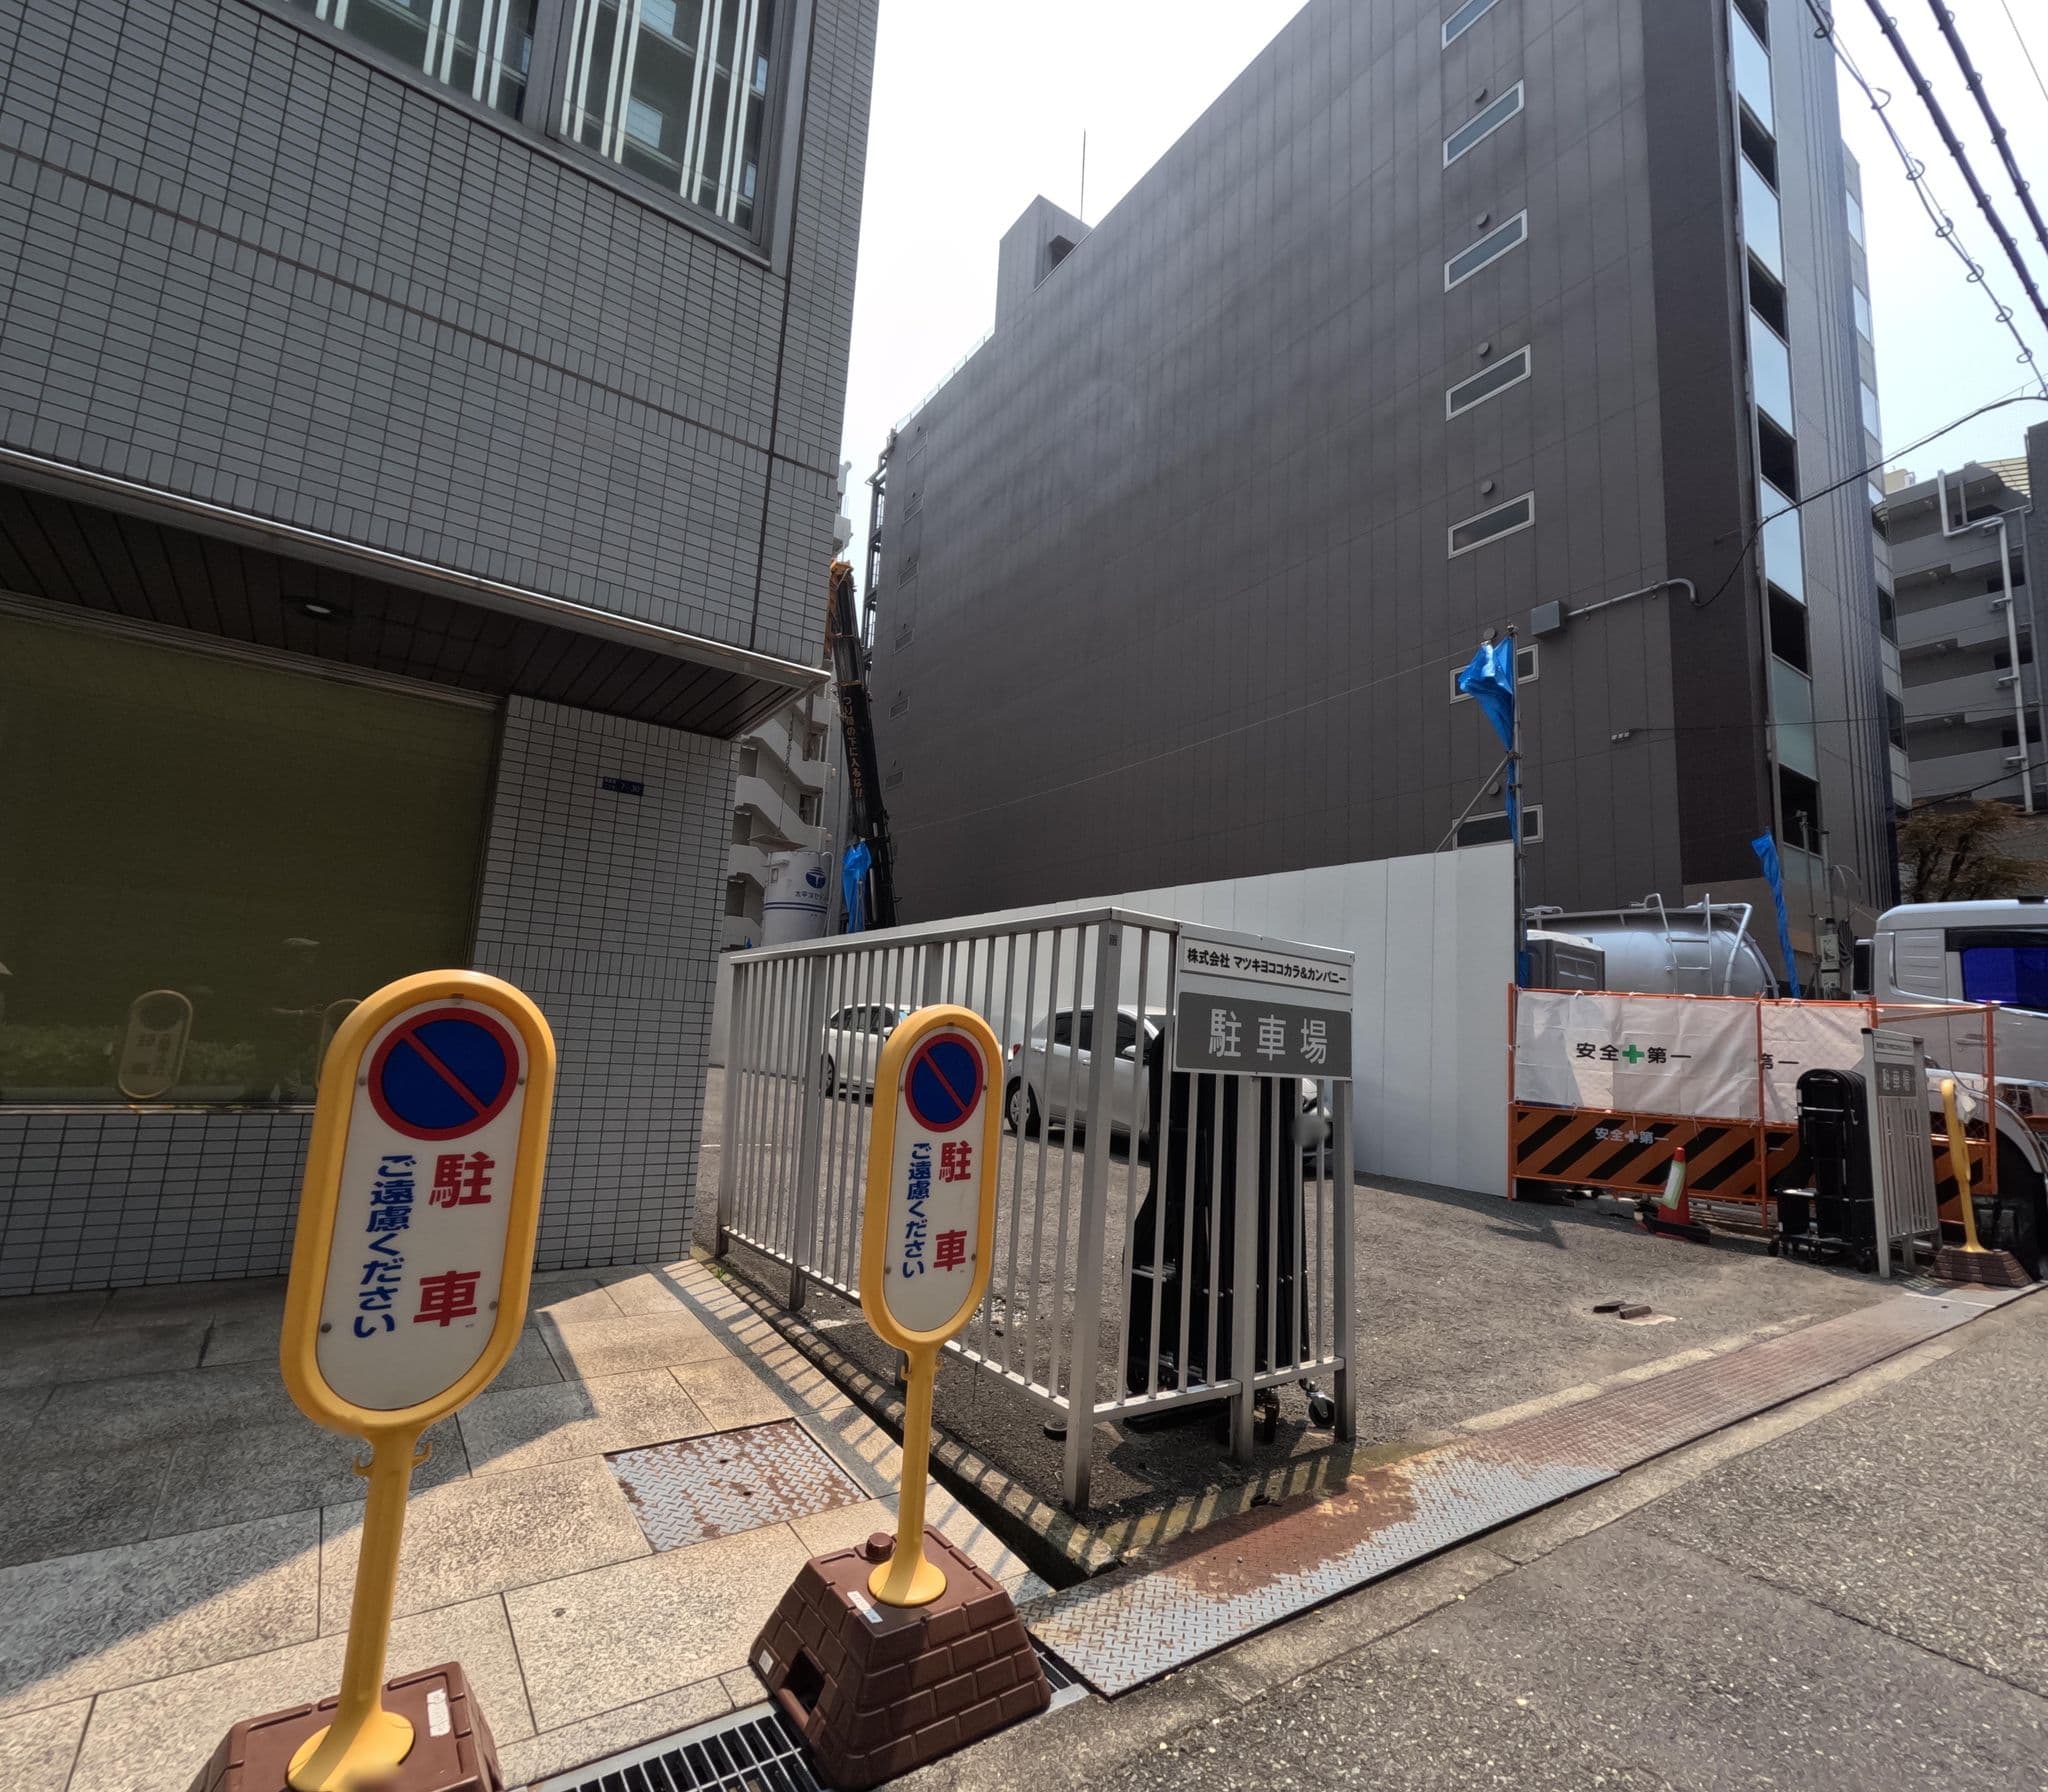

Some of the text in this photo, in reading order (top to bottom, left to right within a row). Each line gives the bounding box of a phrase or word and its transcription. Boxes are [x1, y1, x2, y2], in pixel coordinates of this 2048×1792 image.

[1187, 947, 1230, 969] 株式会社
[1208, 1008, 1328, 1065] 駐車場
[353, 1154, 418, 1339] ご遠慮ください
[902, 1143, 932, 1279] ご遠慮ください
